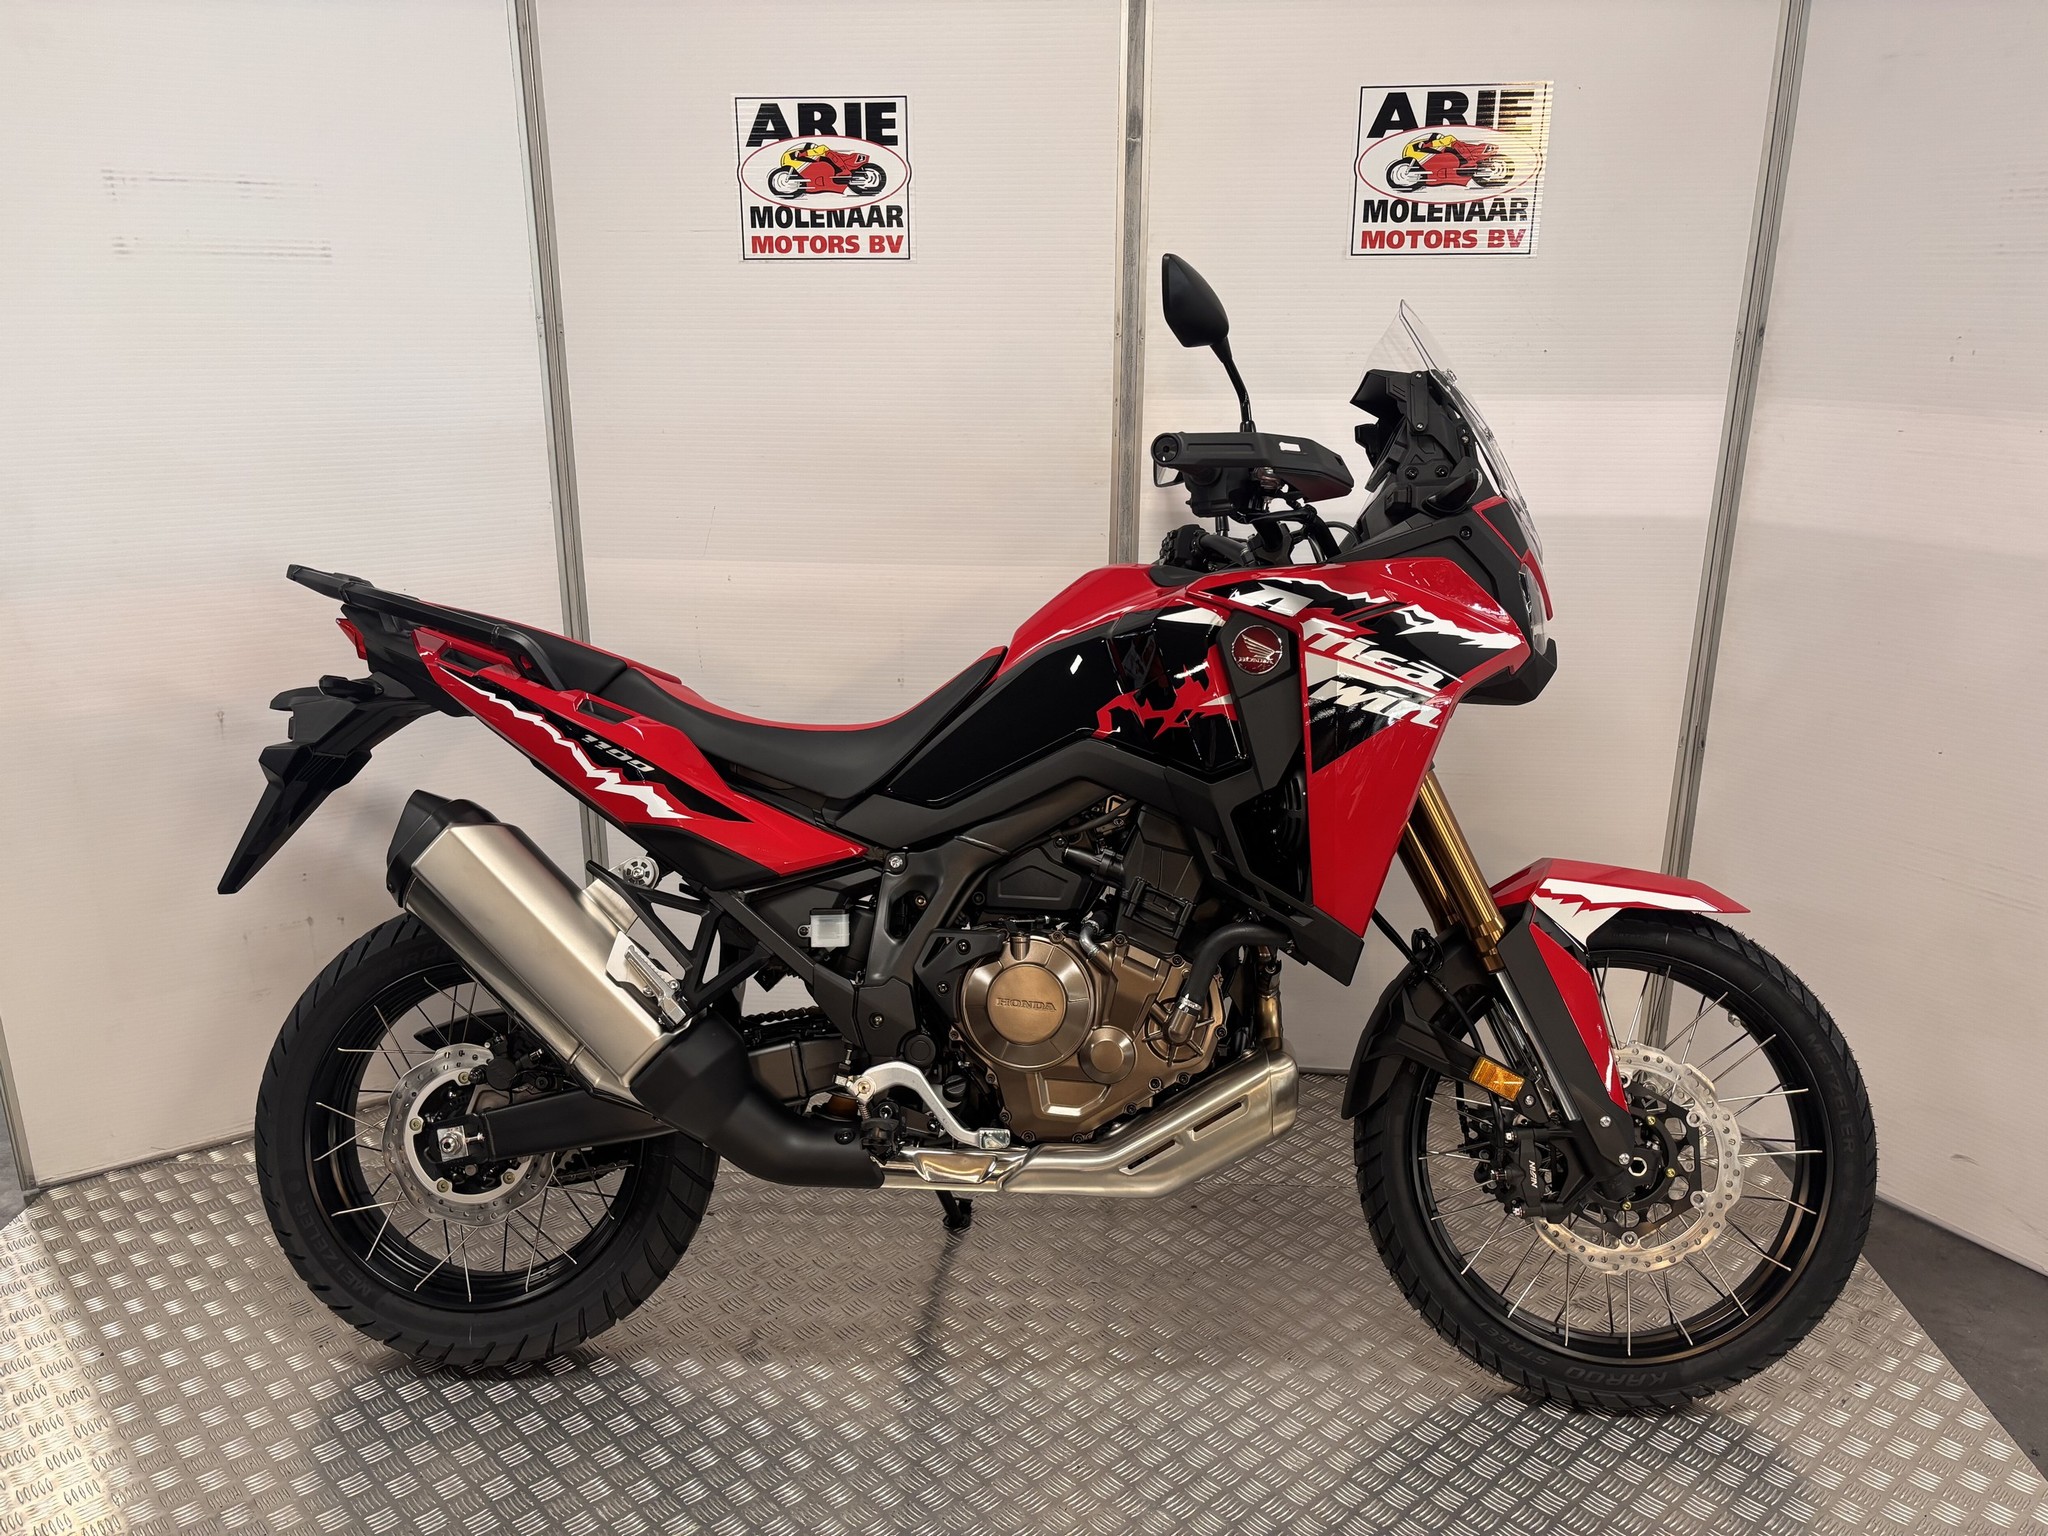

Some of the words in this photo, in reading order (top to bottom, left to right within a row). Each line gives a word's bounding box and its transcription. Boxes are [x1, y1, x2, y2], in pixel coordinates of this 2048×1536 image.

[745, 101, 899, 148] ARIE
[1366, 89, 1535, 139] ARIE
[749, 205, 905, 229] MOLENAAR
[1362, 197, 1530, 224] MOLENAAR
[751, 234, 861, 254] MOTORS
[869, 234, 905, 254] BV
[1361, 229, 1479, 250] MOTORS
[1486, 228, 1527, 249] BV
[581, 733, 656, 773] 1100
[995, 997, 1057, 1012] HONDA
[1807, 1031, 1857, 1154] METZELER
[294, 1200, 376, 1299] METZELER
[1474, 1320, 1553, 1367] STREET
[1564, 1365, 1668, 1387] KAROO
